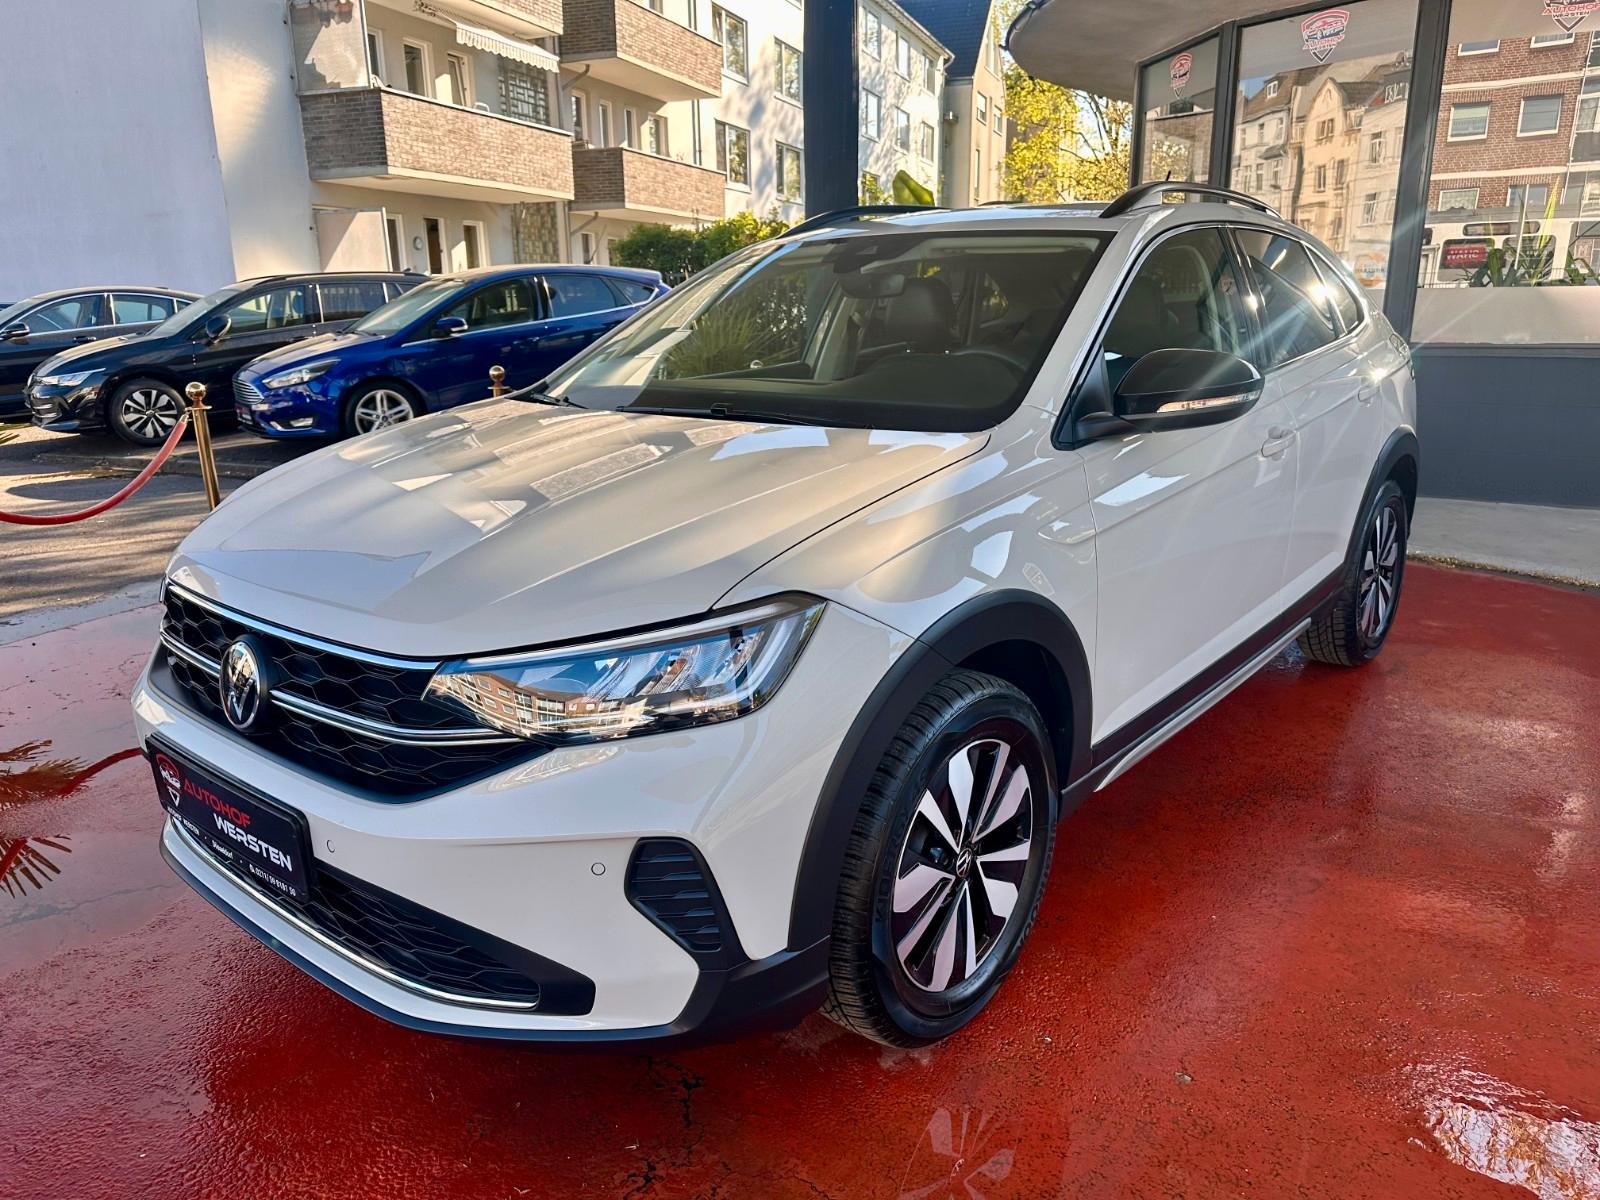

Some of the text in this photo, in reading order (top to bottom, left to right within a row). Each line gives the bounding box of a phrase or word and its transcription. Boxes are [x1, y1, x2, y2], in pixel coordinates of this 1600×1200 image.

[1541, 2, 1600, 16] AUTOHOF
[183, 778, 252, 827] AUTOHOF
[213, 813, 293, 872] WERSTEN
